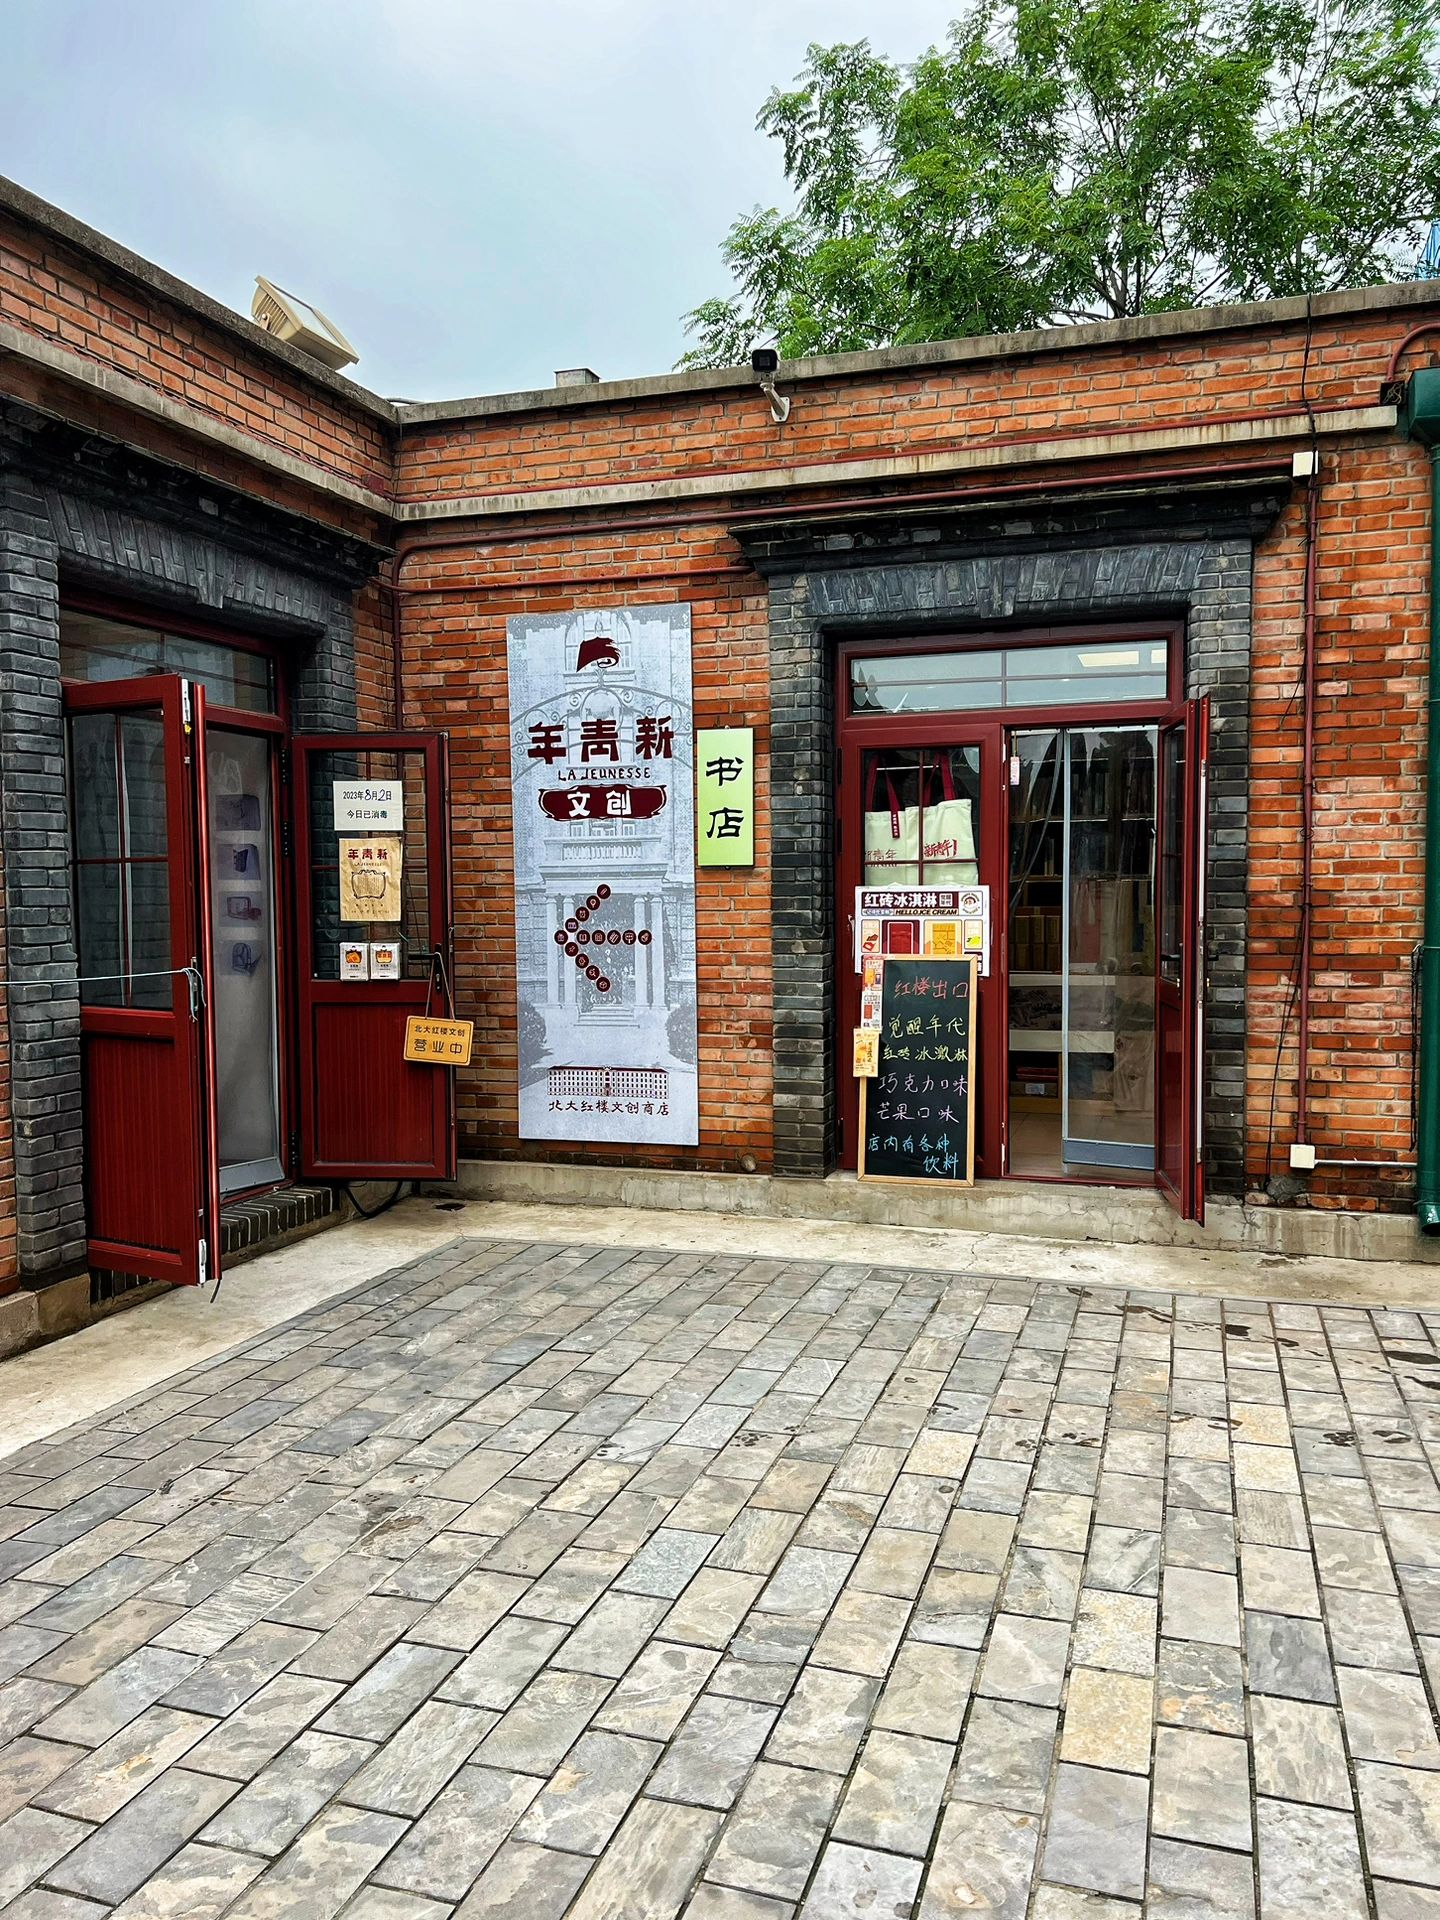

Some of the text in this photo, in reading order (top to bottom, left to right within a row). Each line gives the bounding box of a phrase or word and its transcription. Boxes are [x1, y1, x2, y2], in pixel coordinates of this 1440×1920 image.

[558, 767, 651, 781] LA JEUNESSE
[343, 789, 392, 801] 2023年8月2日
[568, 790, 631, 816] 文创
[706, 756, 744, 839] 书店
[347, 809, 388, 819] 今日已消毒
[864, 892, 937, 908] 红砖冰淇淋
[894, 976, 969, 999] 红楼出口
[415, 1025, 465, 1037] 北大红楼文创
[889, 1013, 966, 1038] 觉醒年代
[414, 1039, 463, 1055] 营业中
[878, 1072, 968, 1096] 巧克力口味
[549, 1099, 670, 1116] 北大红楼文创商店
[877, 1101, 960, 1123] 芒果口味
[868, 1133, 950, 1153] 店内有各种
[923, 1152, 959, 1179] 饮料
